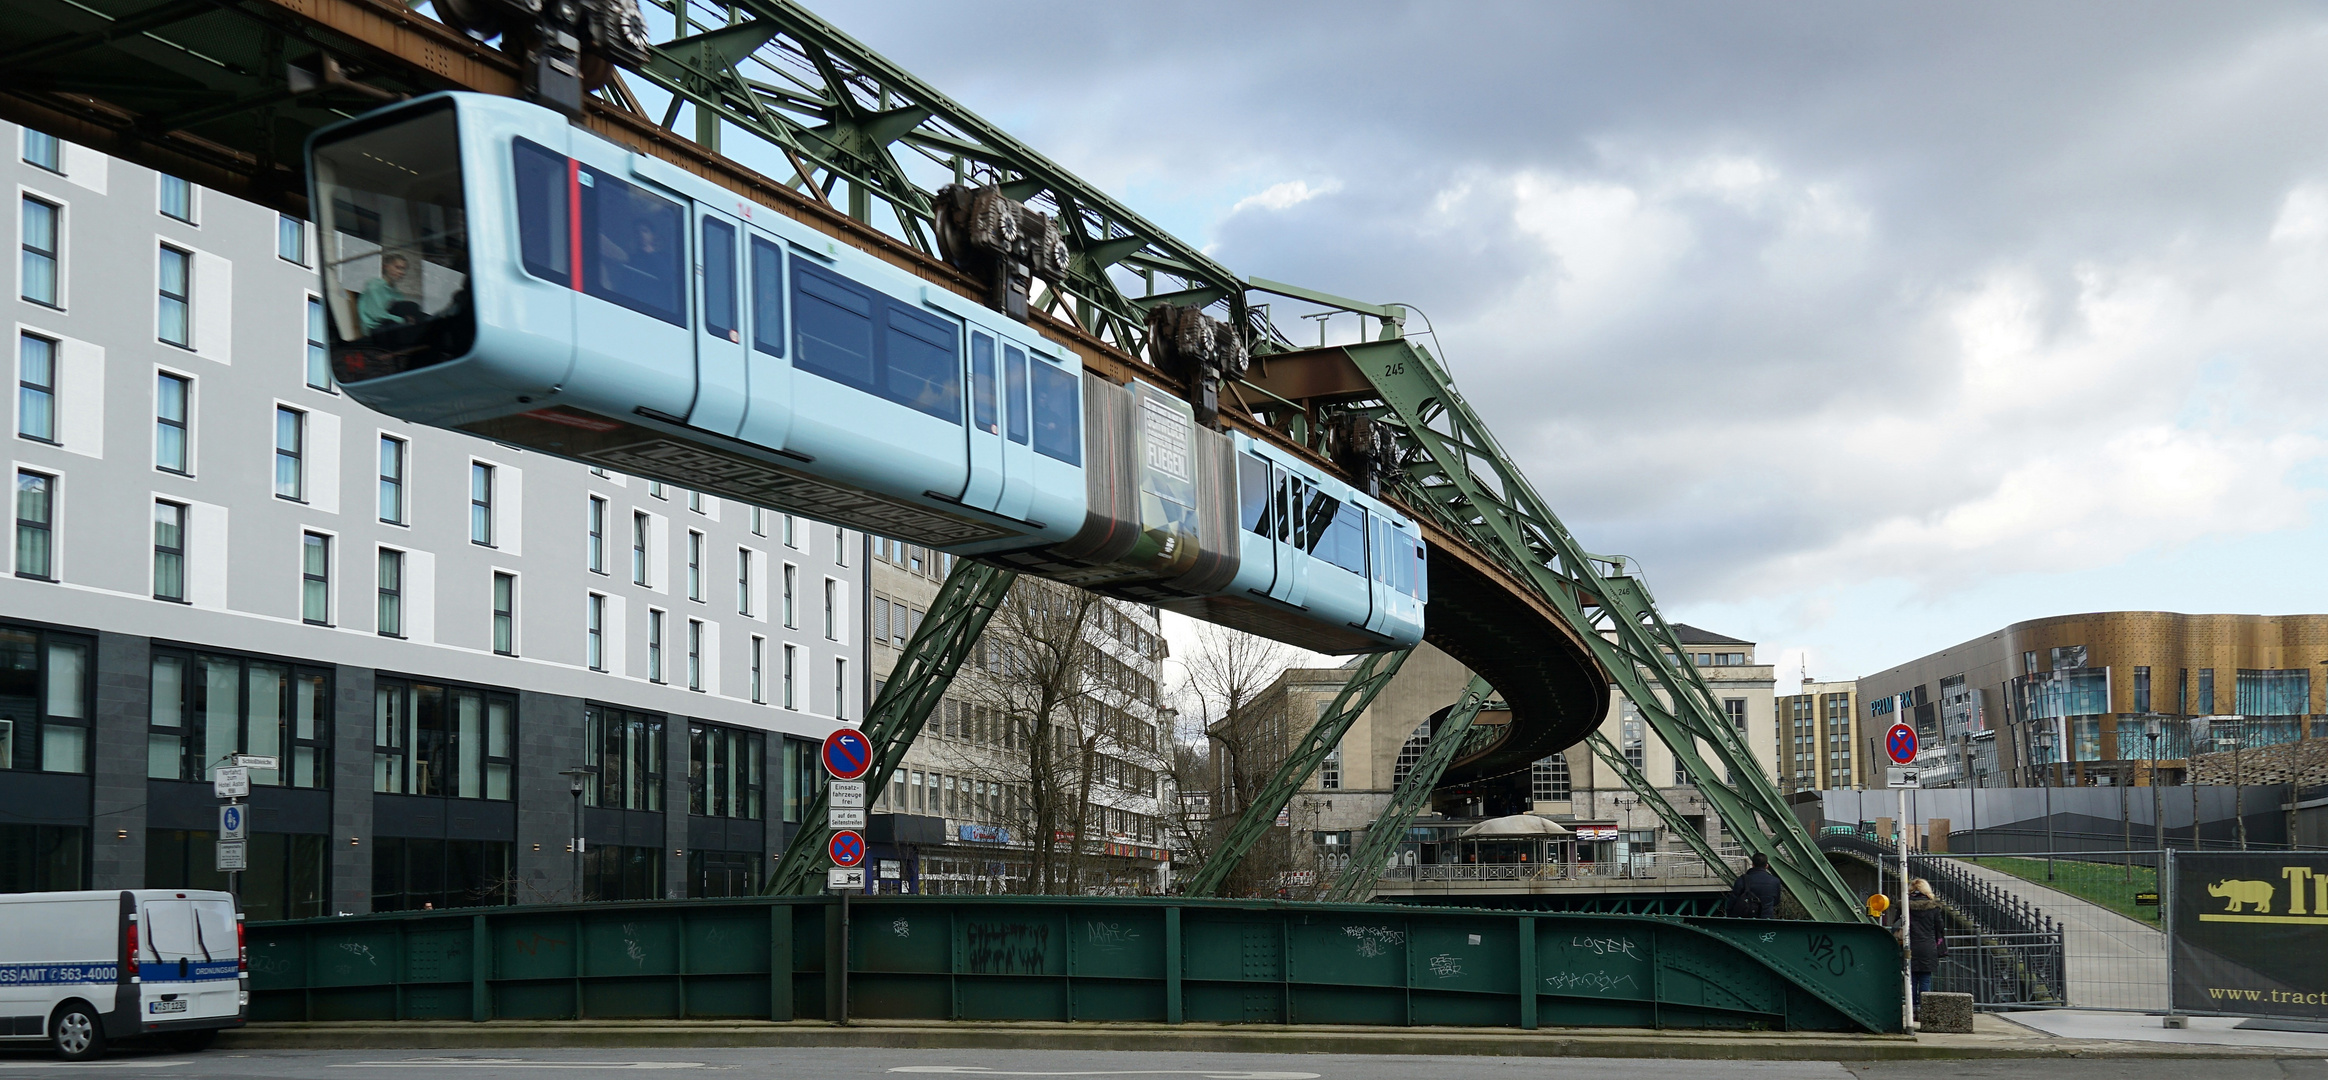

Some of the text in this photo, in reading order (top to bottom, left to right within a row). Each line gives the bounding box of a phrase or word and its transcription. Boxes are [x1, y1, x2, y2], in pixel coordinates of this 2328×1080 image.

[1385, 362, 1405, 377] 245
[1618, 588, 1630, 596] 246
[1870, 689, 1914, 717] PRIMRK
[1572, 935, 1642, 961] LOSER
[60, 967, 117, 980] 563-4000
[195, 966, 239, 975] ORDNUNGSAMT
